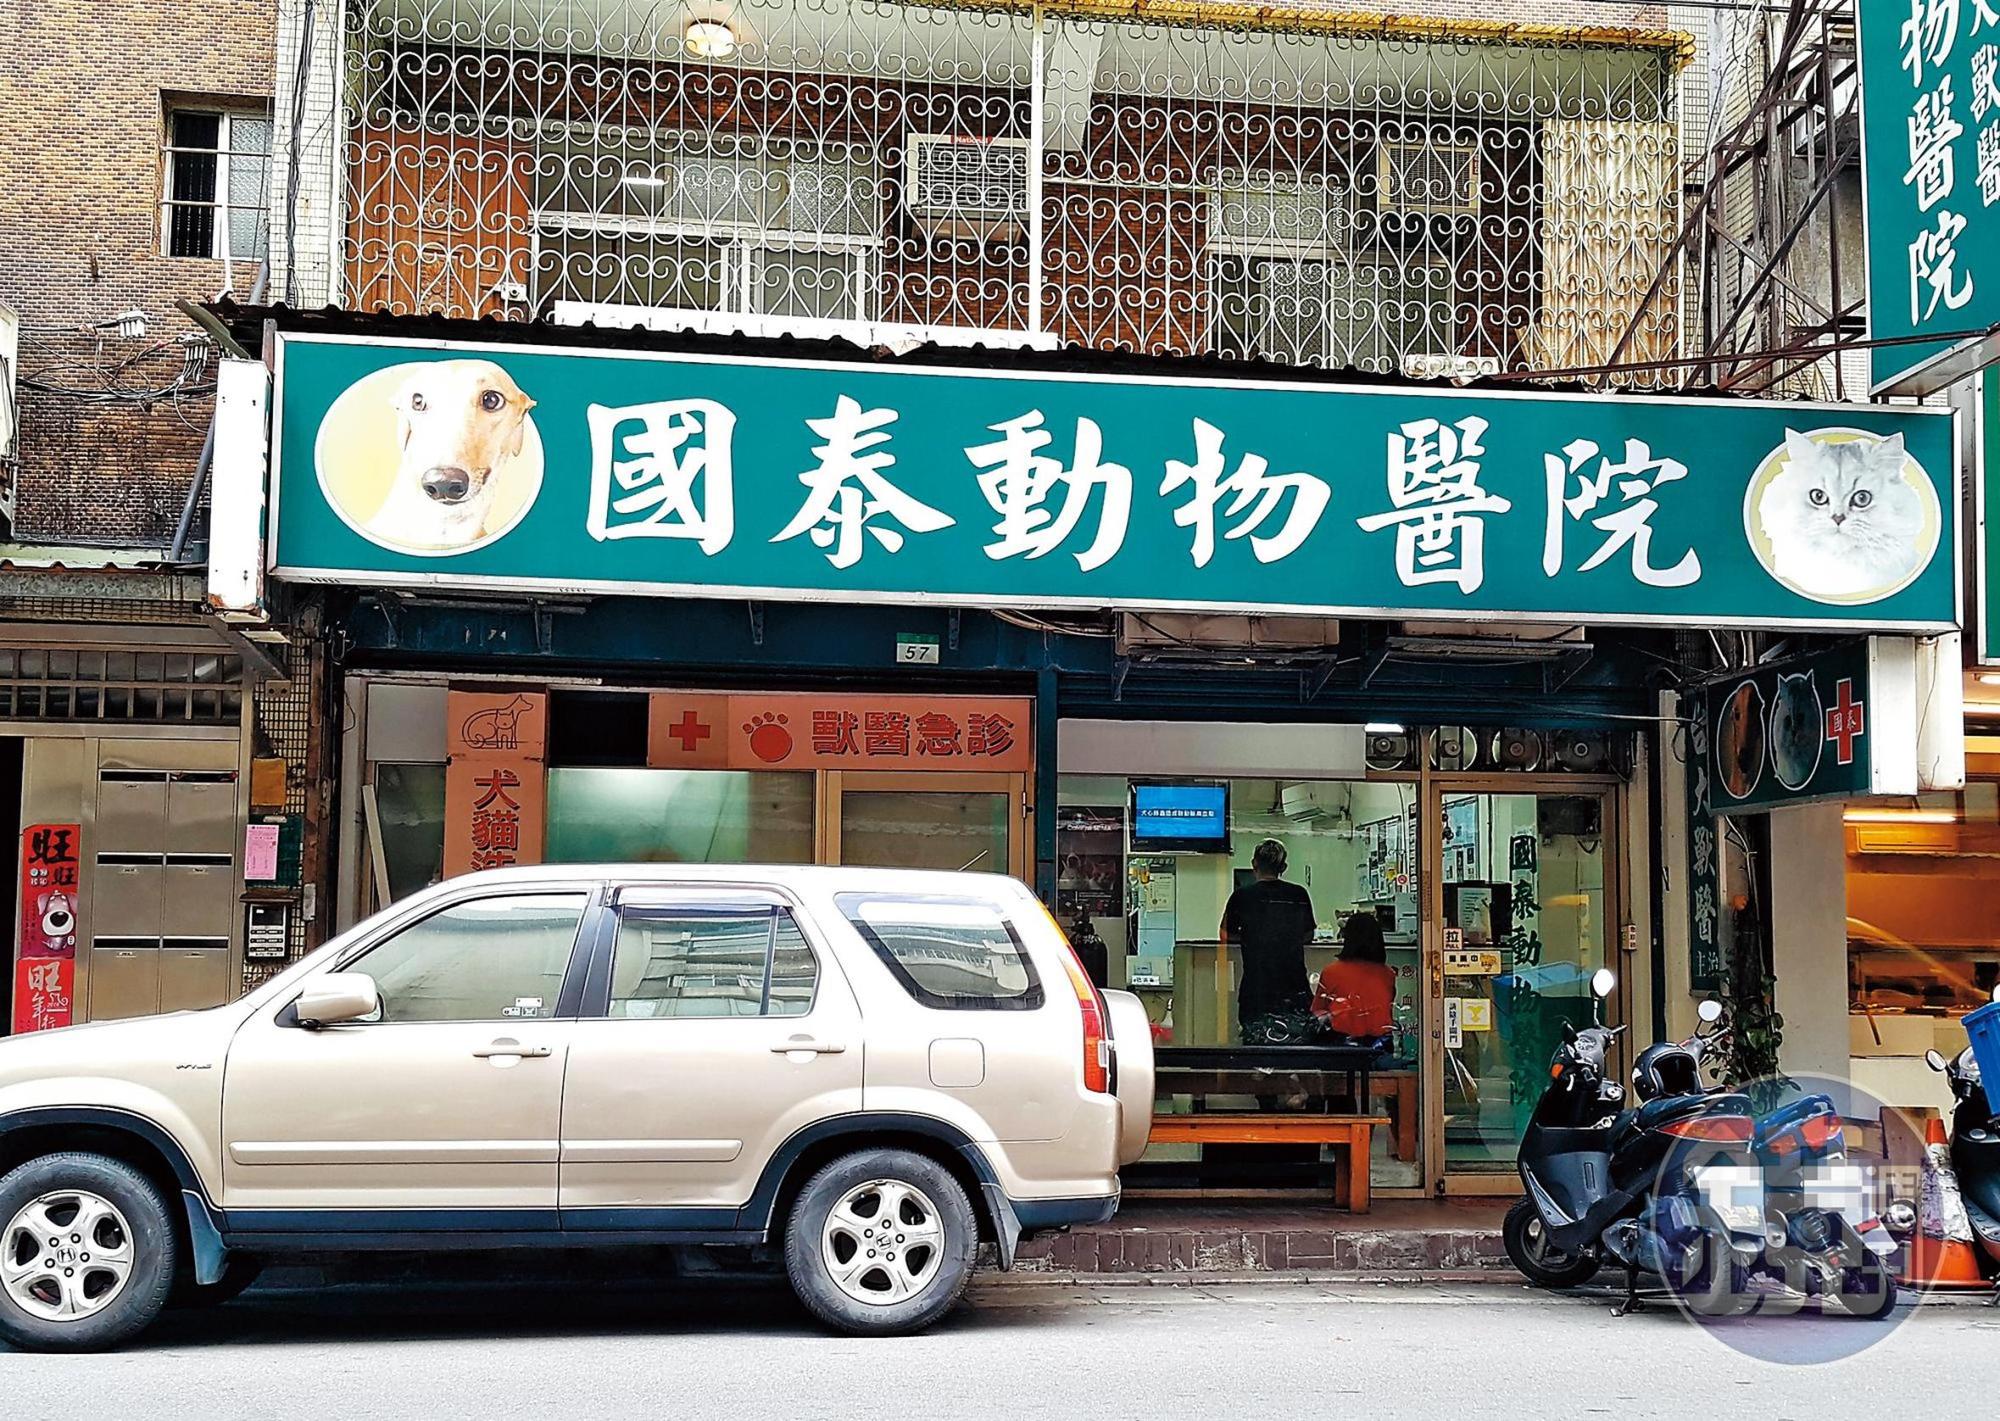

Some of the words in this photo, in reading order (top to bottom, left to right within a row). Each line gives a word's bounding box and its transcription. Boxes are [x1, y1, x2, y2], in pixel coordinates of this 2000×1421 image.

[586, 394, 1702, 596] 國泰動物醫院
[905, 646, 930, 660] 57
[812, 710, 1015, 757] 獸醫急診
[1446, 931, 1459, 943] 拉
